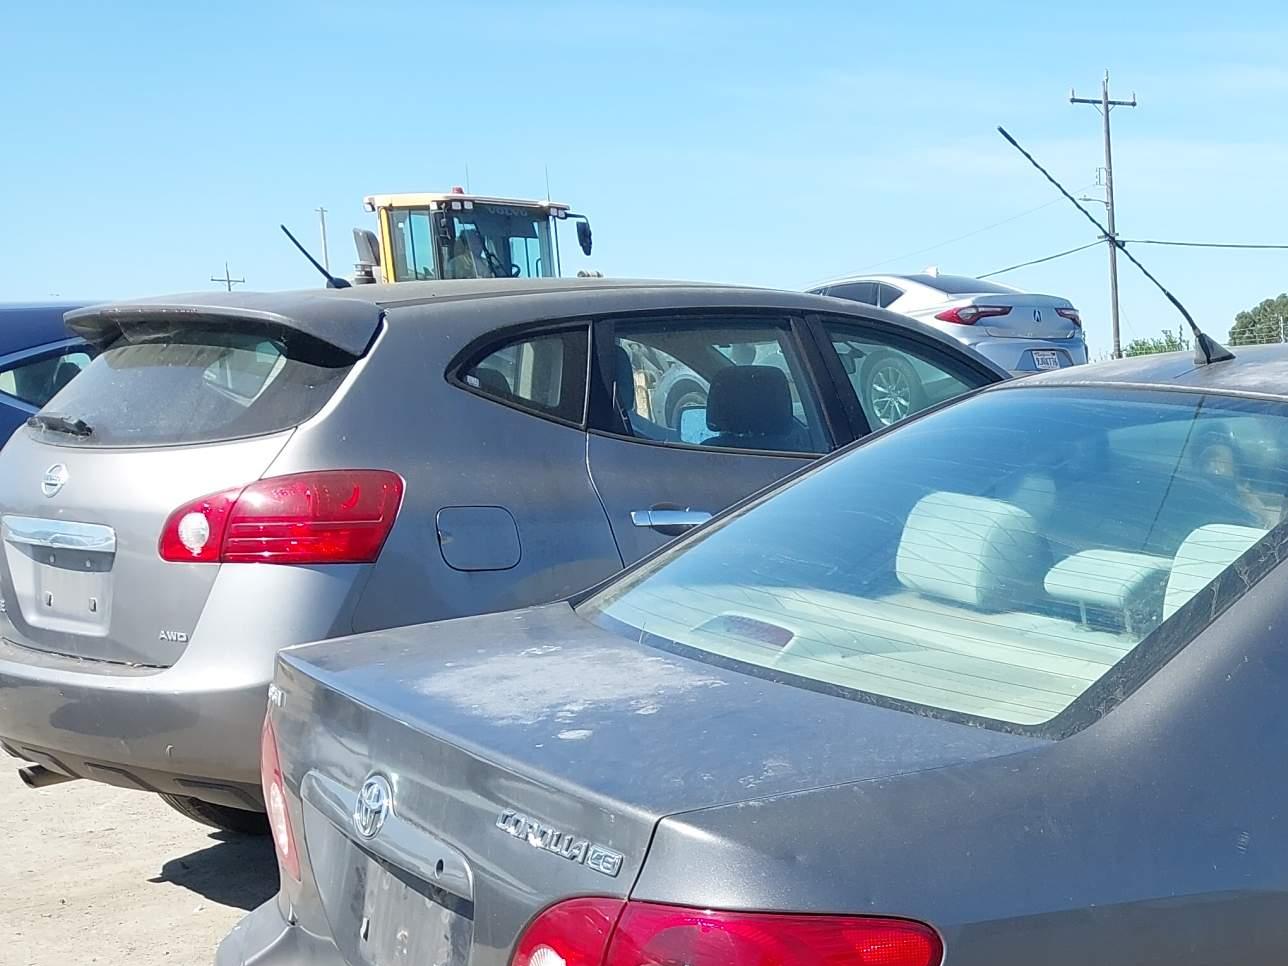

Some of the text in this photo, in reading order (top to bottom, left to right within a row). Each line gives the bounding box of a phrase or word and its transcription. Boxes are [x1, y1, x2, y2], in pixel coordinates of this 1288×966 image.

[488, 206, 528, 217] VOLVO
[159, 630, 189, 642] AWD
[496, 807, 591, 865] COROLLA
